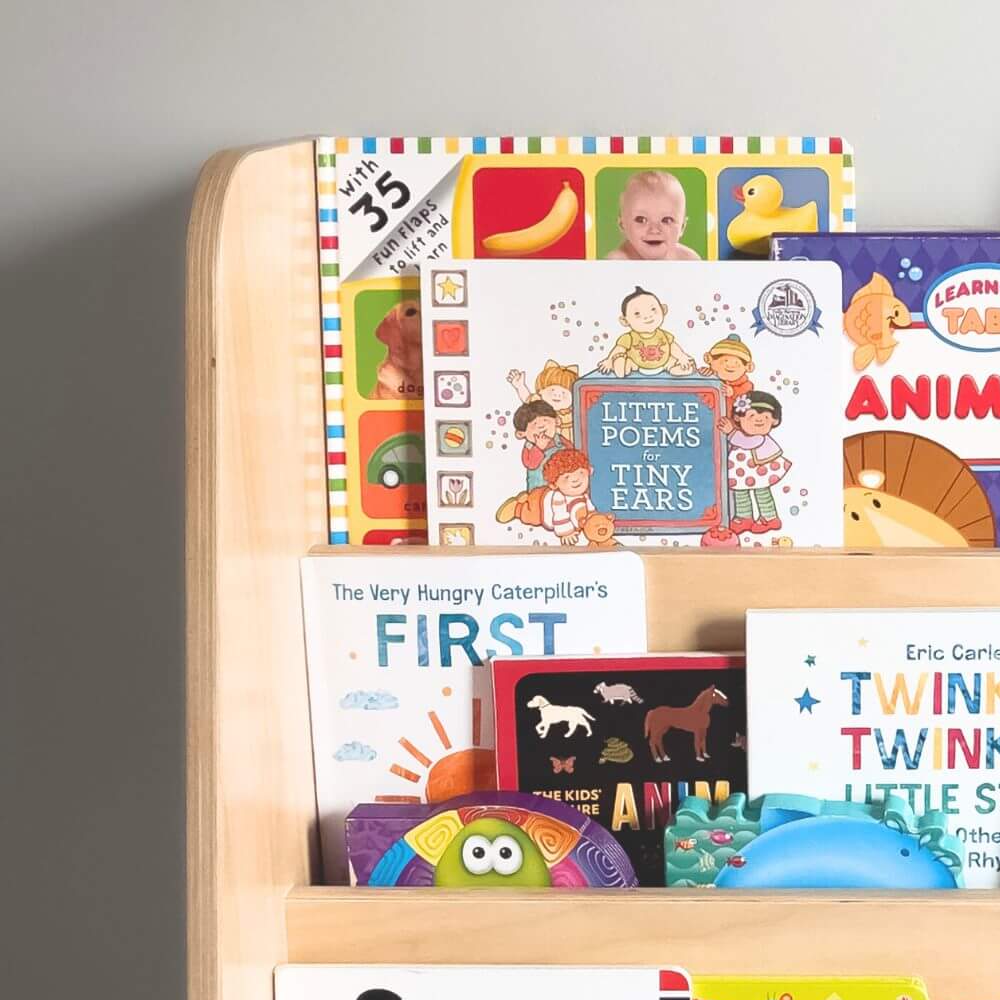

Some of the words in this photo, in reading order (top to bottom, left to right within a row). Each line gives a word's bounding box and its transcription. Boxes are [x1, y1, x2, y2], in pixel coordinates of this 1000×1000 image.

[339, 157, 379, 197] With
[348, 171, 411, 233] 35
[389, 253, 407, 274] to
[404, 236, 427, 262] lift
[427, 214, 449, 238] and
[601, 402, 699, 423] LITTLE
[601, 426, 700, 447] POEMS
[642, 451, 661, 463] for
[611, 464, 693, 487] TINY
[611, 488, 694, 511] EARS
[333, 583, 364, 601] The
[369, 584, 410, 606] Very
[418, 583, 484, 605] Hungry
[491, 580, 608, 604] Caterpillar's
[376, 612, 567, 667] FIRST
[906, 644, 945, 661] Eric
